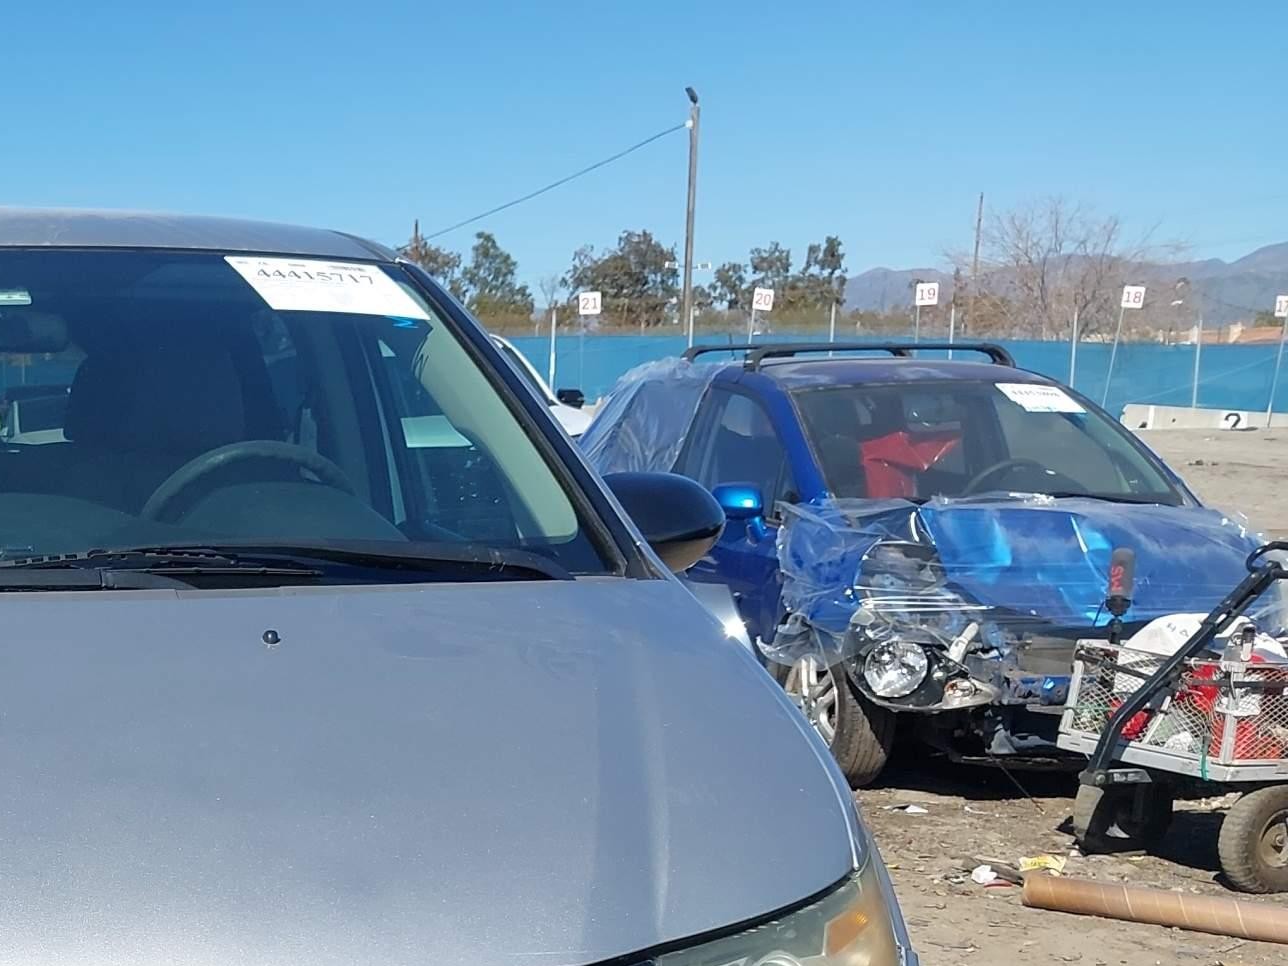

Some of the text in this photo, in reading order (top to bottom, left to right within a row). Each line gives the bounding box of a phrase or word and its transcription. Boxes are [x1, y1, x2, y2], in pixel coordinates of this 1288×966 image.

[257, 268, 374, 285] 44415717
[755, 292, 771, 306] 20
[919, 287, 936, 301] 19
[1124, 290, 1143, 304] 18
[581, 297, 598, 311] 21
